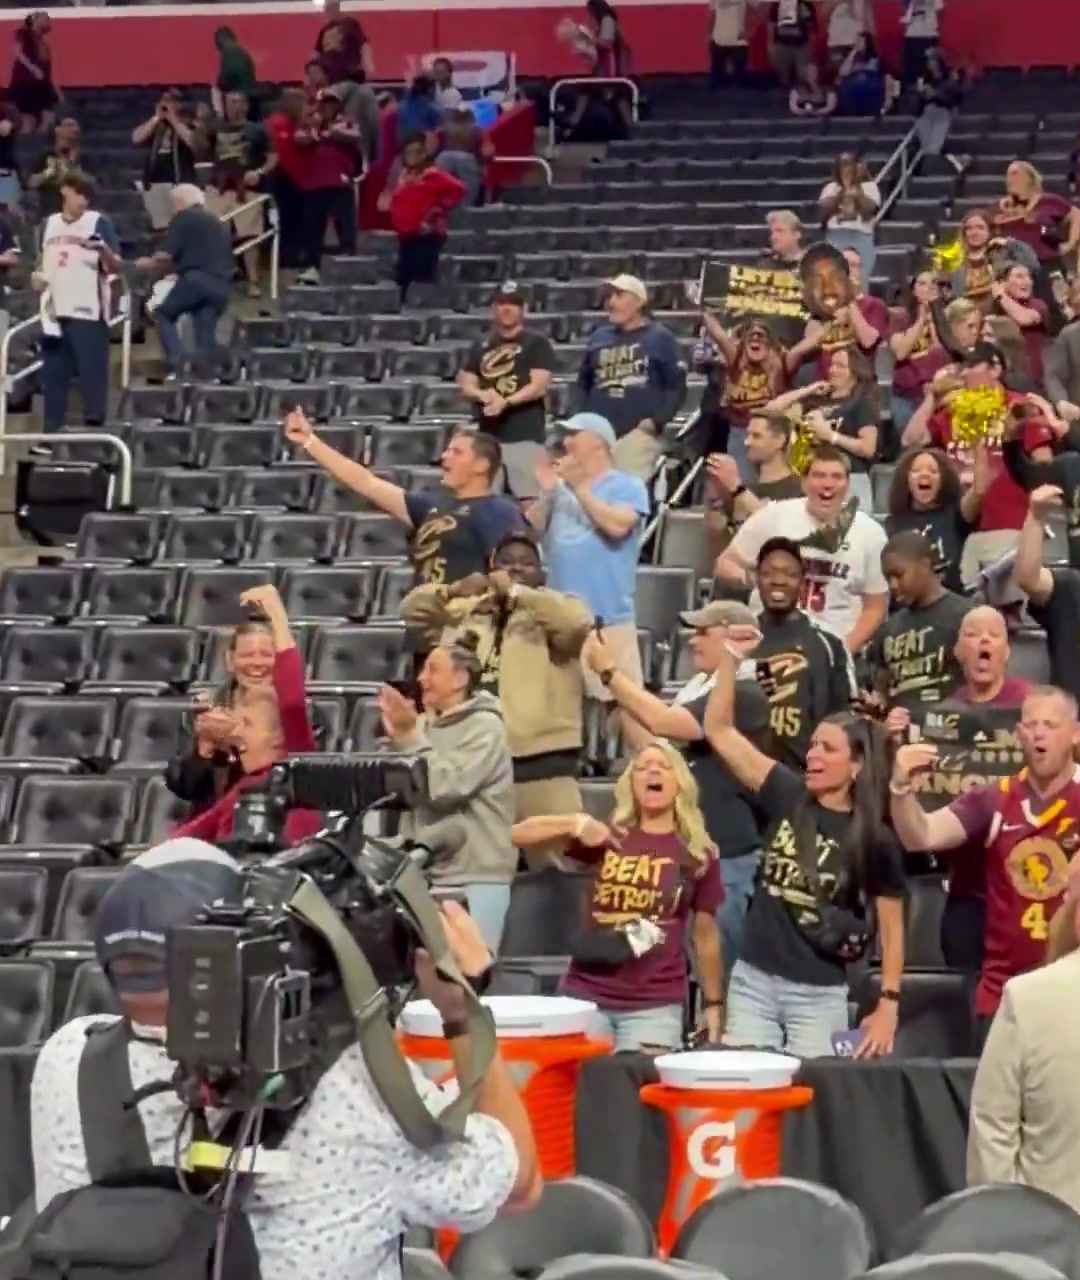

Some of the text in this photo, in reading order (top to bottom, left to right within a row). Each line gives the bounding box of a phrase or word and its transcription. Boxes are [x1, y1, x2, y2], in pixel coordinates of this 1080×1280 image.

[769, 705, 801, 737] 45
[600, 849, 675, 887] BEAT
[687, 1121, 736, 1179] G
